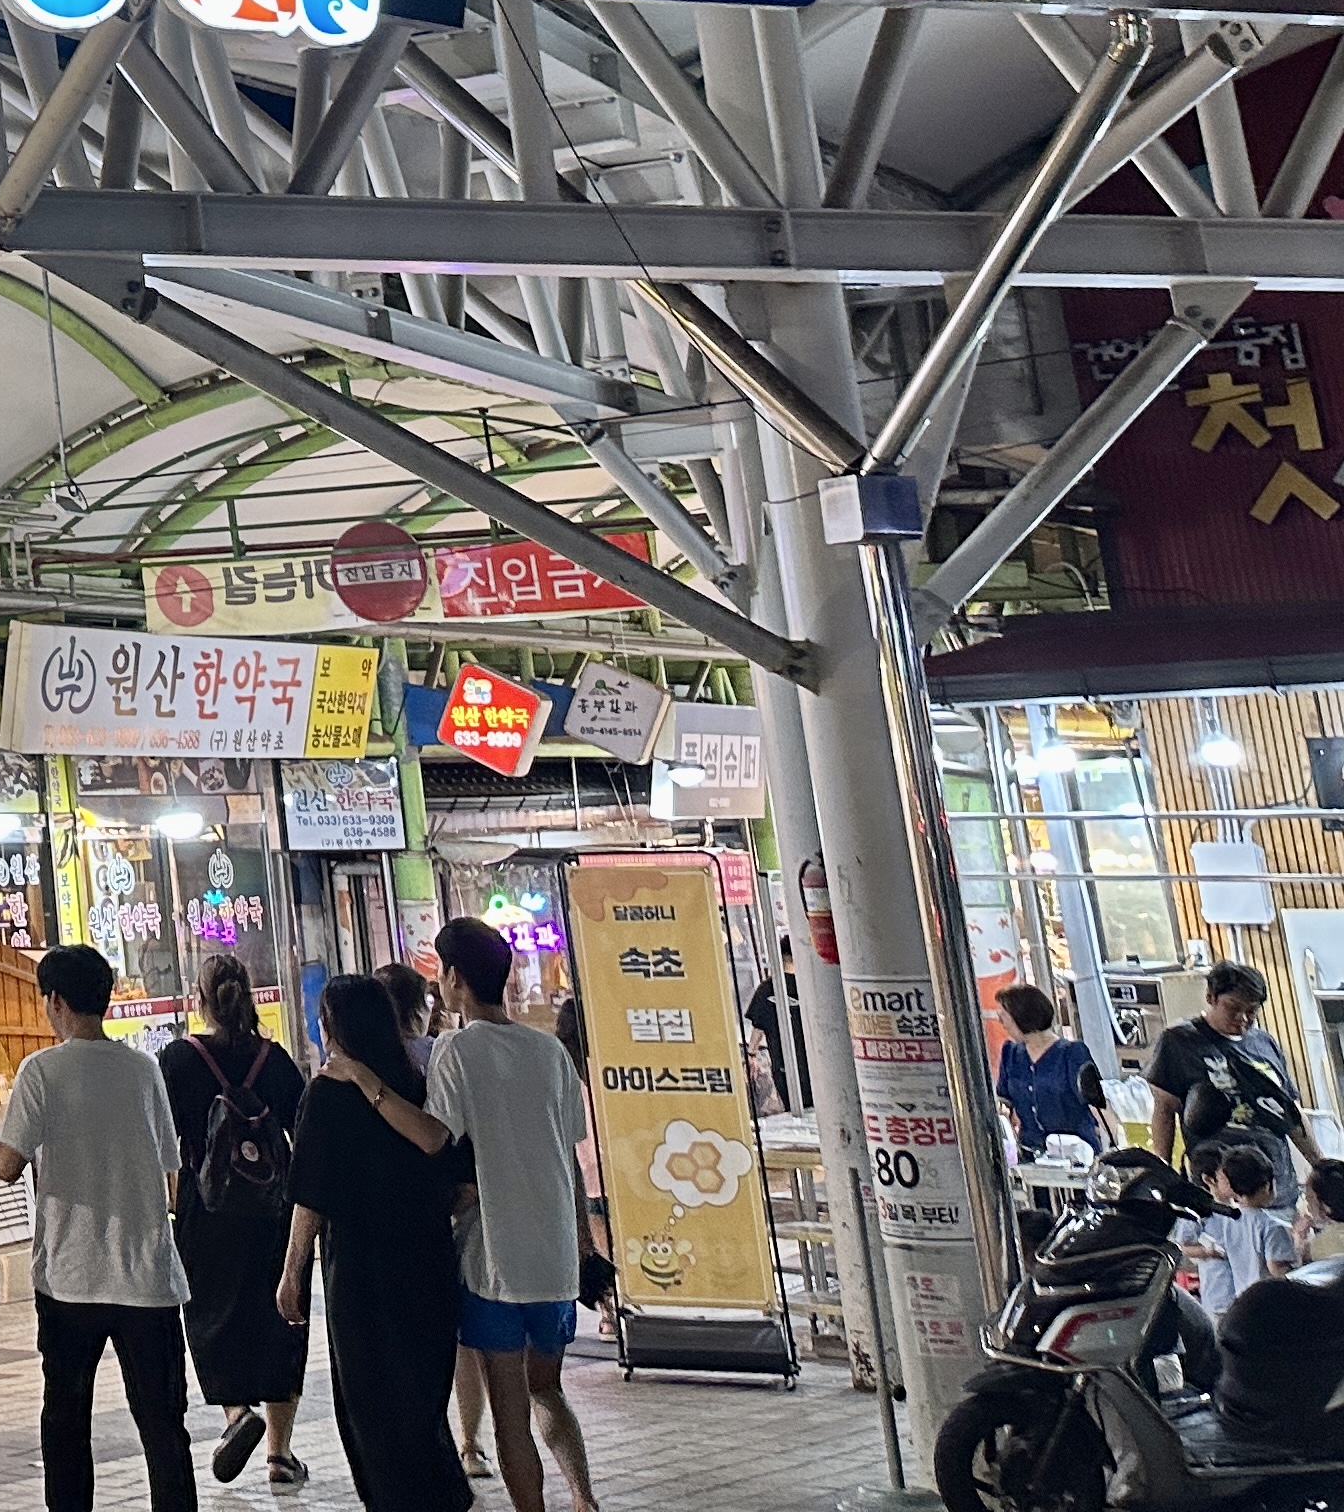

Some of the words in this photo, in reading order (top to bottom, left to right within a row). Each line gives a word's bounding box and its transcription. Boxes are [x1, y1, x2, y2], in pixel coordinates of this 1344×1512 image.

[342, 563, 417, 582] 진입금지
[458, 550, 602, 605] 진입금
[450, 705, 481, 727] 원산
[483, 706, 530, 729] 한약국
[210, 729, 228, 753] (구)
[232, 729, 285, 754] 원산약초
[453, 730, 522, 748] 633-9309
[336, 788, 395, 812] 한약국
[343, 827, 397, 838] 636-4588
[9, 853, 41, 886] 원산
[612, 904, 676, 922] 달콤허니
[618, 946, 686, 980] 속초
[849, 987, 927, 1014] emart
[625, 1008, 695, 1044] 벌집
[602, 1065, 734, 1095] 아이스크림
[921, 1205, 960, 1225] 부터!
